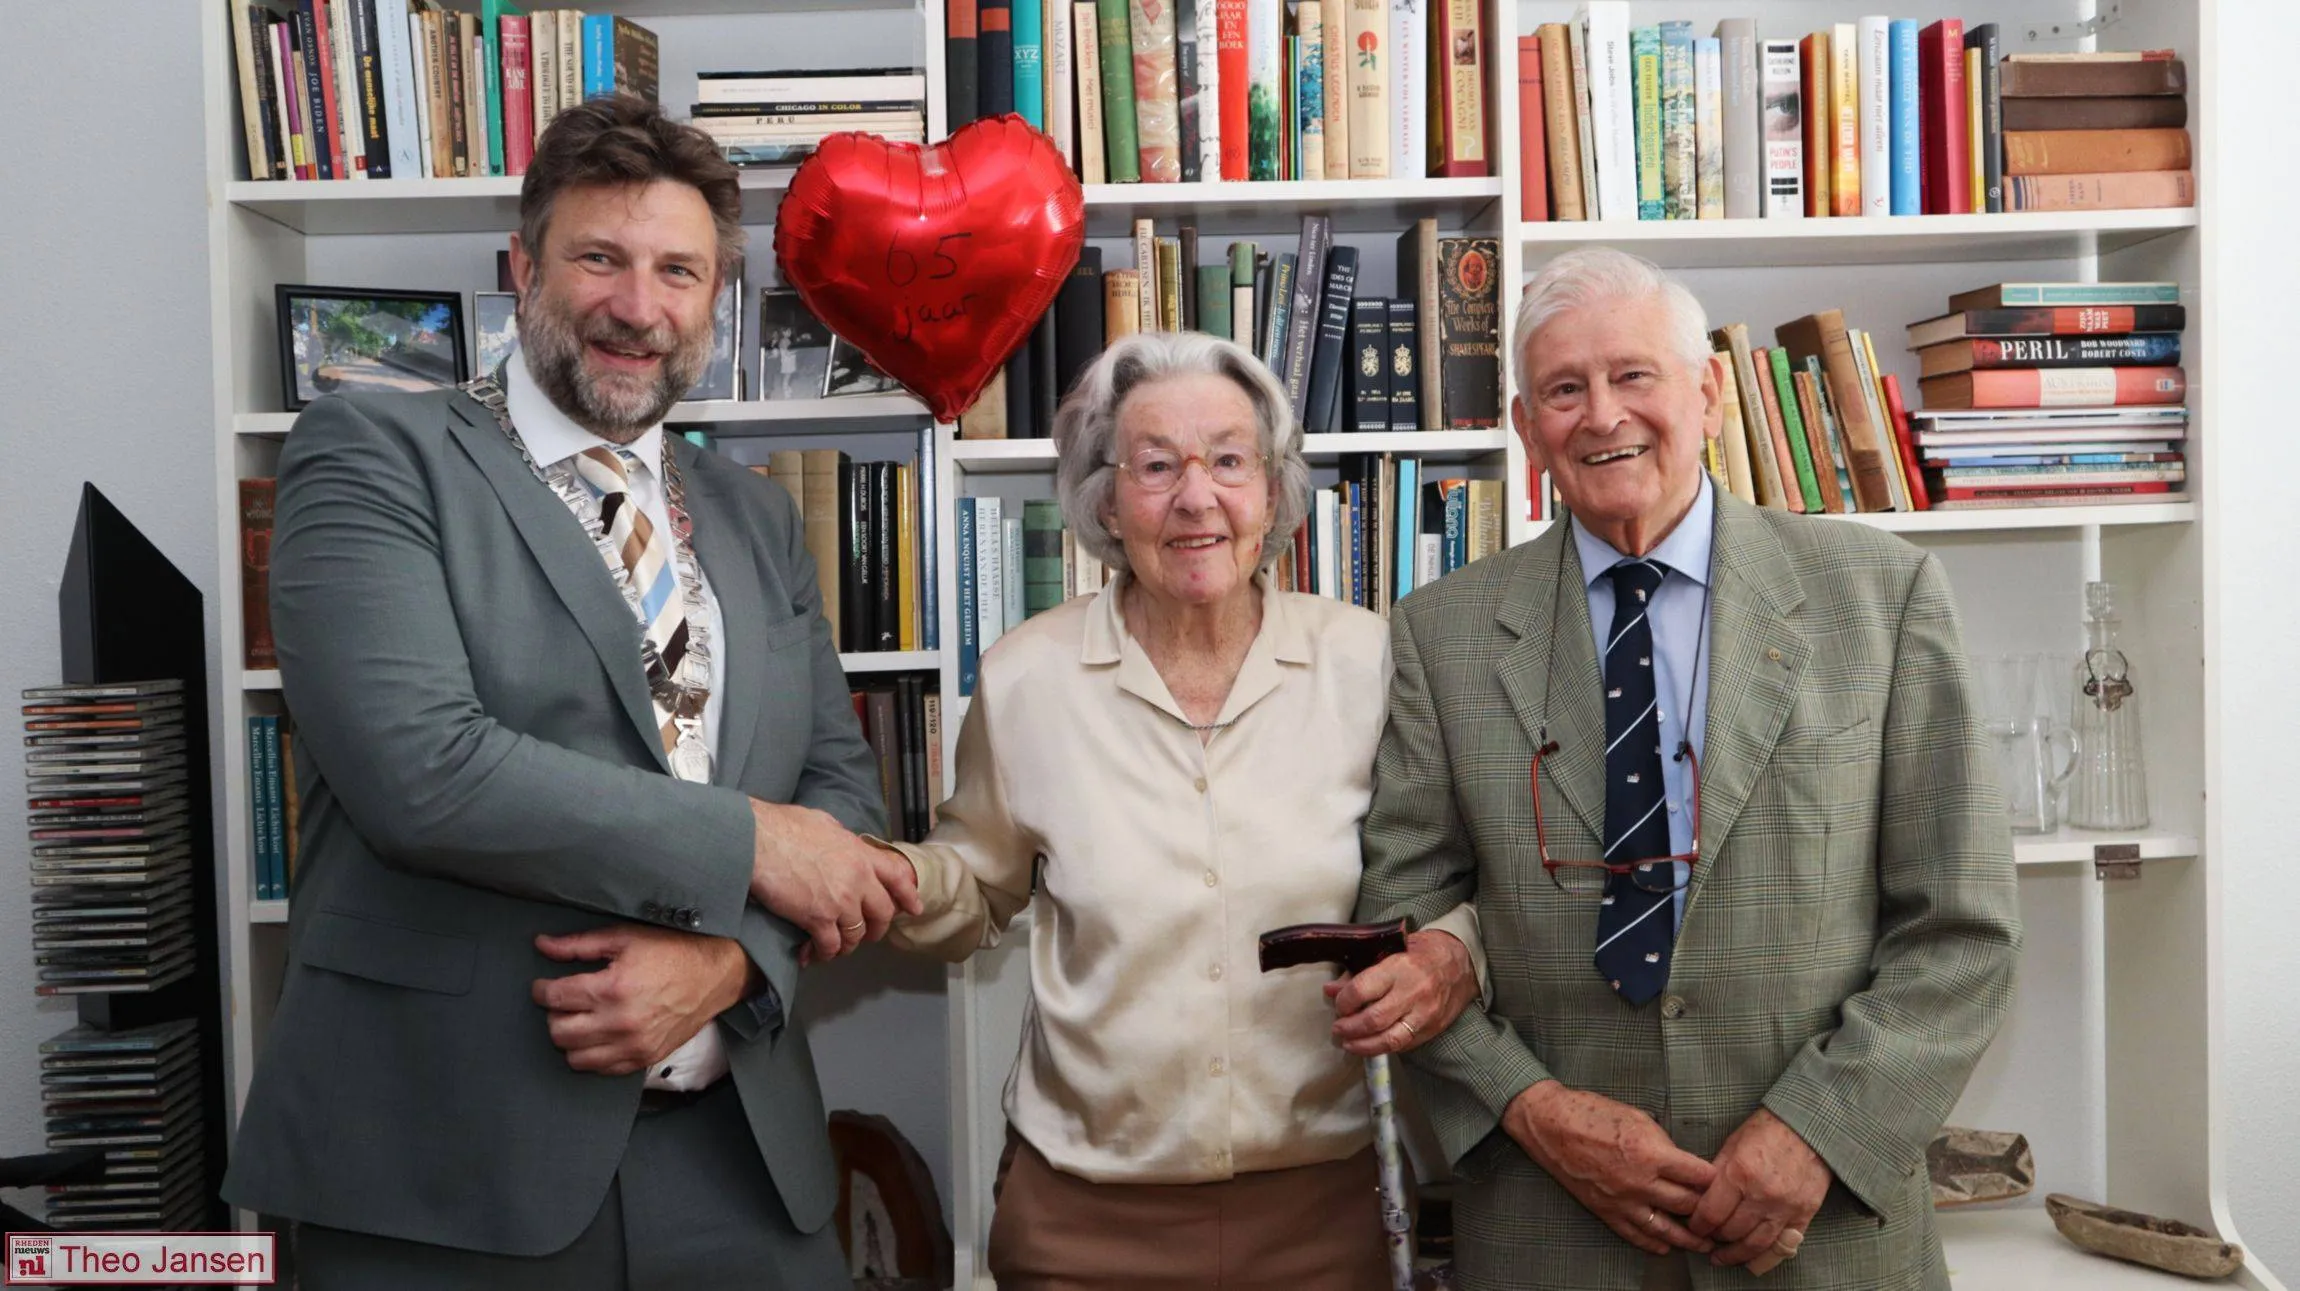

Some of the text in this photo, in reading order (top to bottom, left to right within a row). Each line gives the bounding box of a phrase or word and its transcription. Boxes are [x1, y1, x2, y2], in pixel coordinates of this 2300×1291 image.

[1220, 11, 1242, 20] JAAR
[1224, 21, 1238, 30] EN
[565, 42, 574, 56] THE
[1014, 49, 1039, 59] XYZ
[1054, 20, 1065, 75] MOZART
[1219, 41, 1244, 49] BOEK
[1606, 41, 1614, 63] Steve
[430, 29, 443, 99] ANOTHER COUNTRY
[309, 72, 320, 92] JOE
[363, 55, 372, 66] De
[369, 117, 381, 139] maat
[1456, 70, 1465, 130] COCAGNE
[312, 98, 324, 133] BIDEN
[776, 104, 816, 112] CHICAGO
[755, 117, 796, 125] PERU
[1769, 147, 1797, 157] PUTIN'S
[1769, 159, 1797, 170] PEOPLE
[887, 229, 973, 287] 65
[1337, 264, 1351, 273] THE
[1329, 282, 1352, 292] MARCH
[892, 294, 978, 343] jaar
[1445, 301, 1460, 317] The
[1298, 319, 1309, 337] Het
[1452, 315, 1480, 332] Works
[1999, 340, 2069, 361] PERIL
[2080, 339, 2146, 349] BOB WOODWARD
[2081, 349, 2146, 358] ROBERT COSTA
[1293, 340, 1307, 376] verhaal
[962, 536, 971, 576] ENQUIST
[251, 726, 260, 769] Marcellus
[266, 726, 276, 768] Marcellus
[931, 743, 940, 777] TIRADE
[254, 770, 262, 802] Emants
